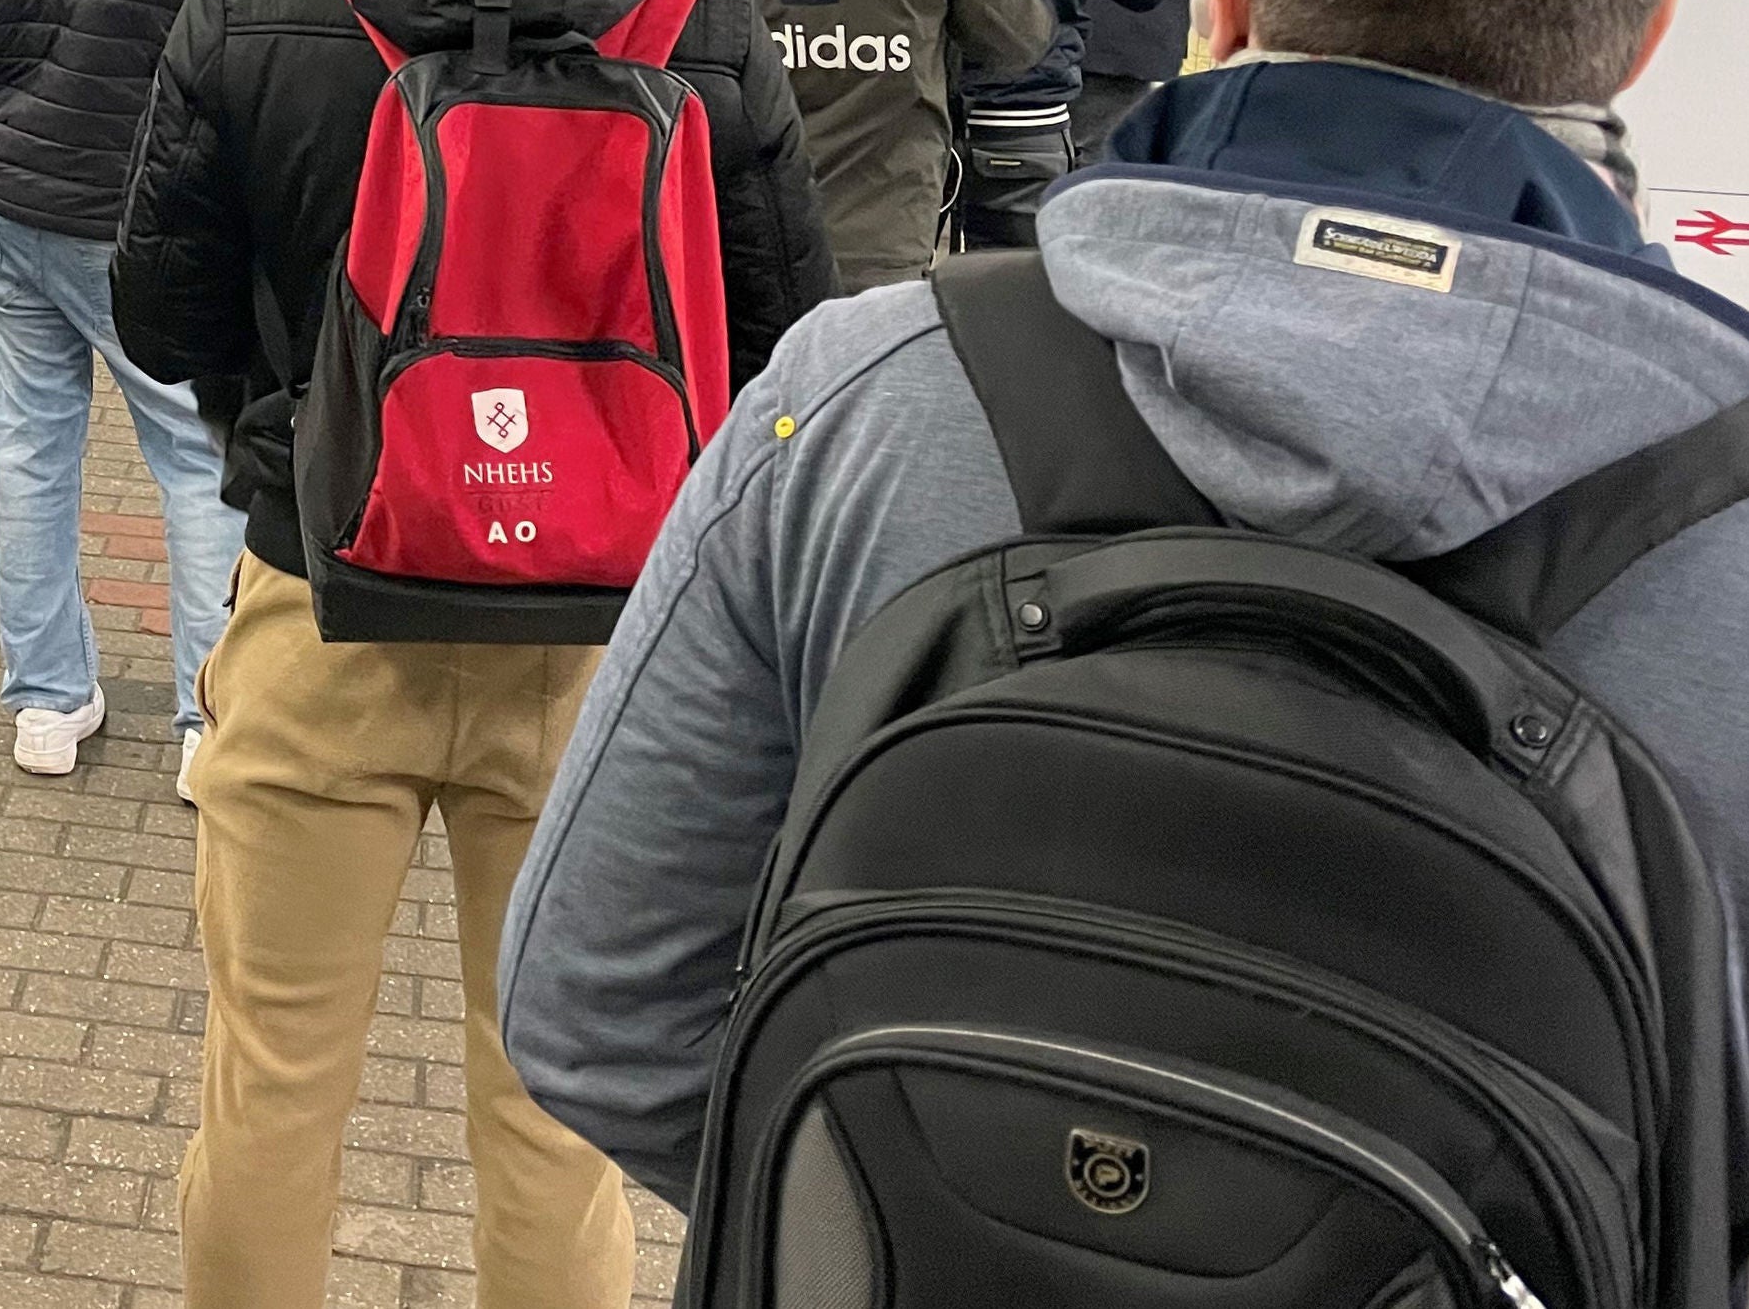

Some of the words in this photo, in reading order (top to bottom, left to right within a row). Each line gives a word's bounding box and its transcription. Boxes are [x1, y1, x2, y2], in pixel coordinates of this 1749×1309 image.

[463, 461, 554, 485] NHEHS
[487, 521, 509, 544] A
[514, 520, 537, 543] O
